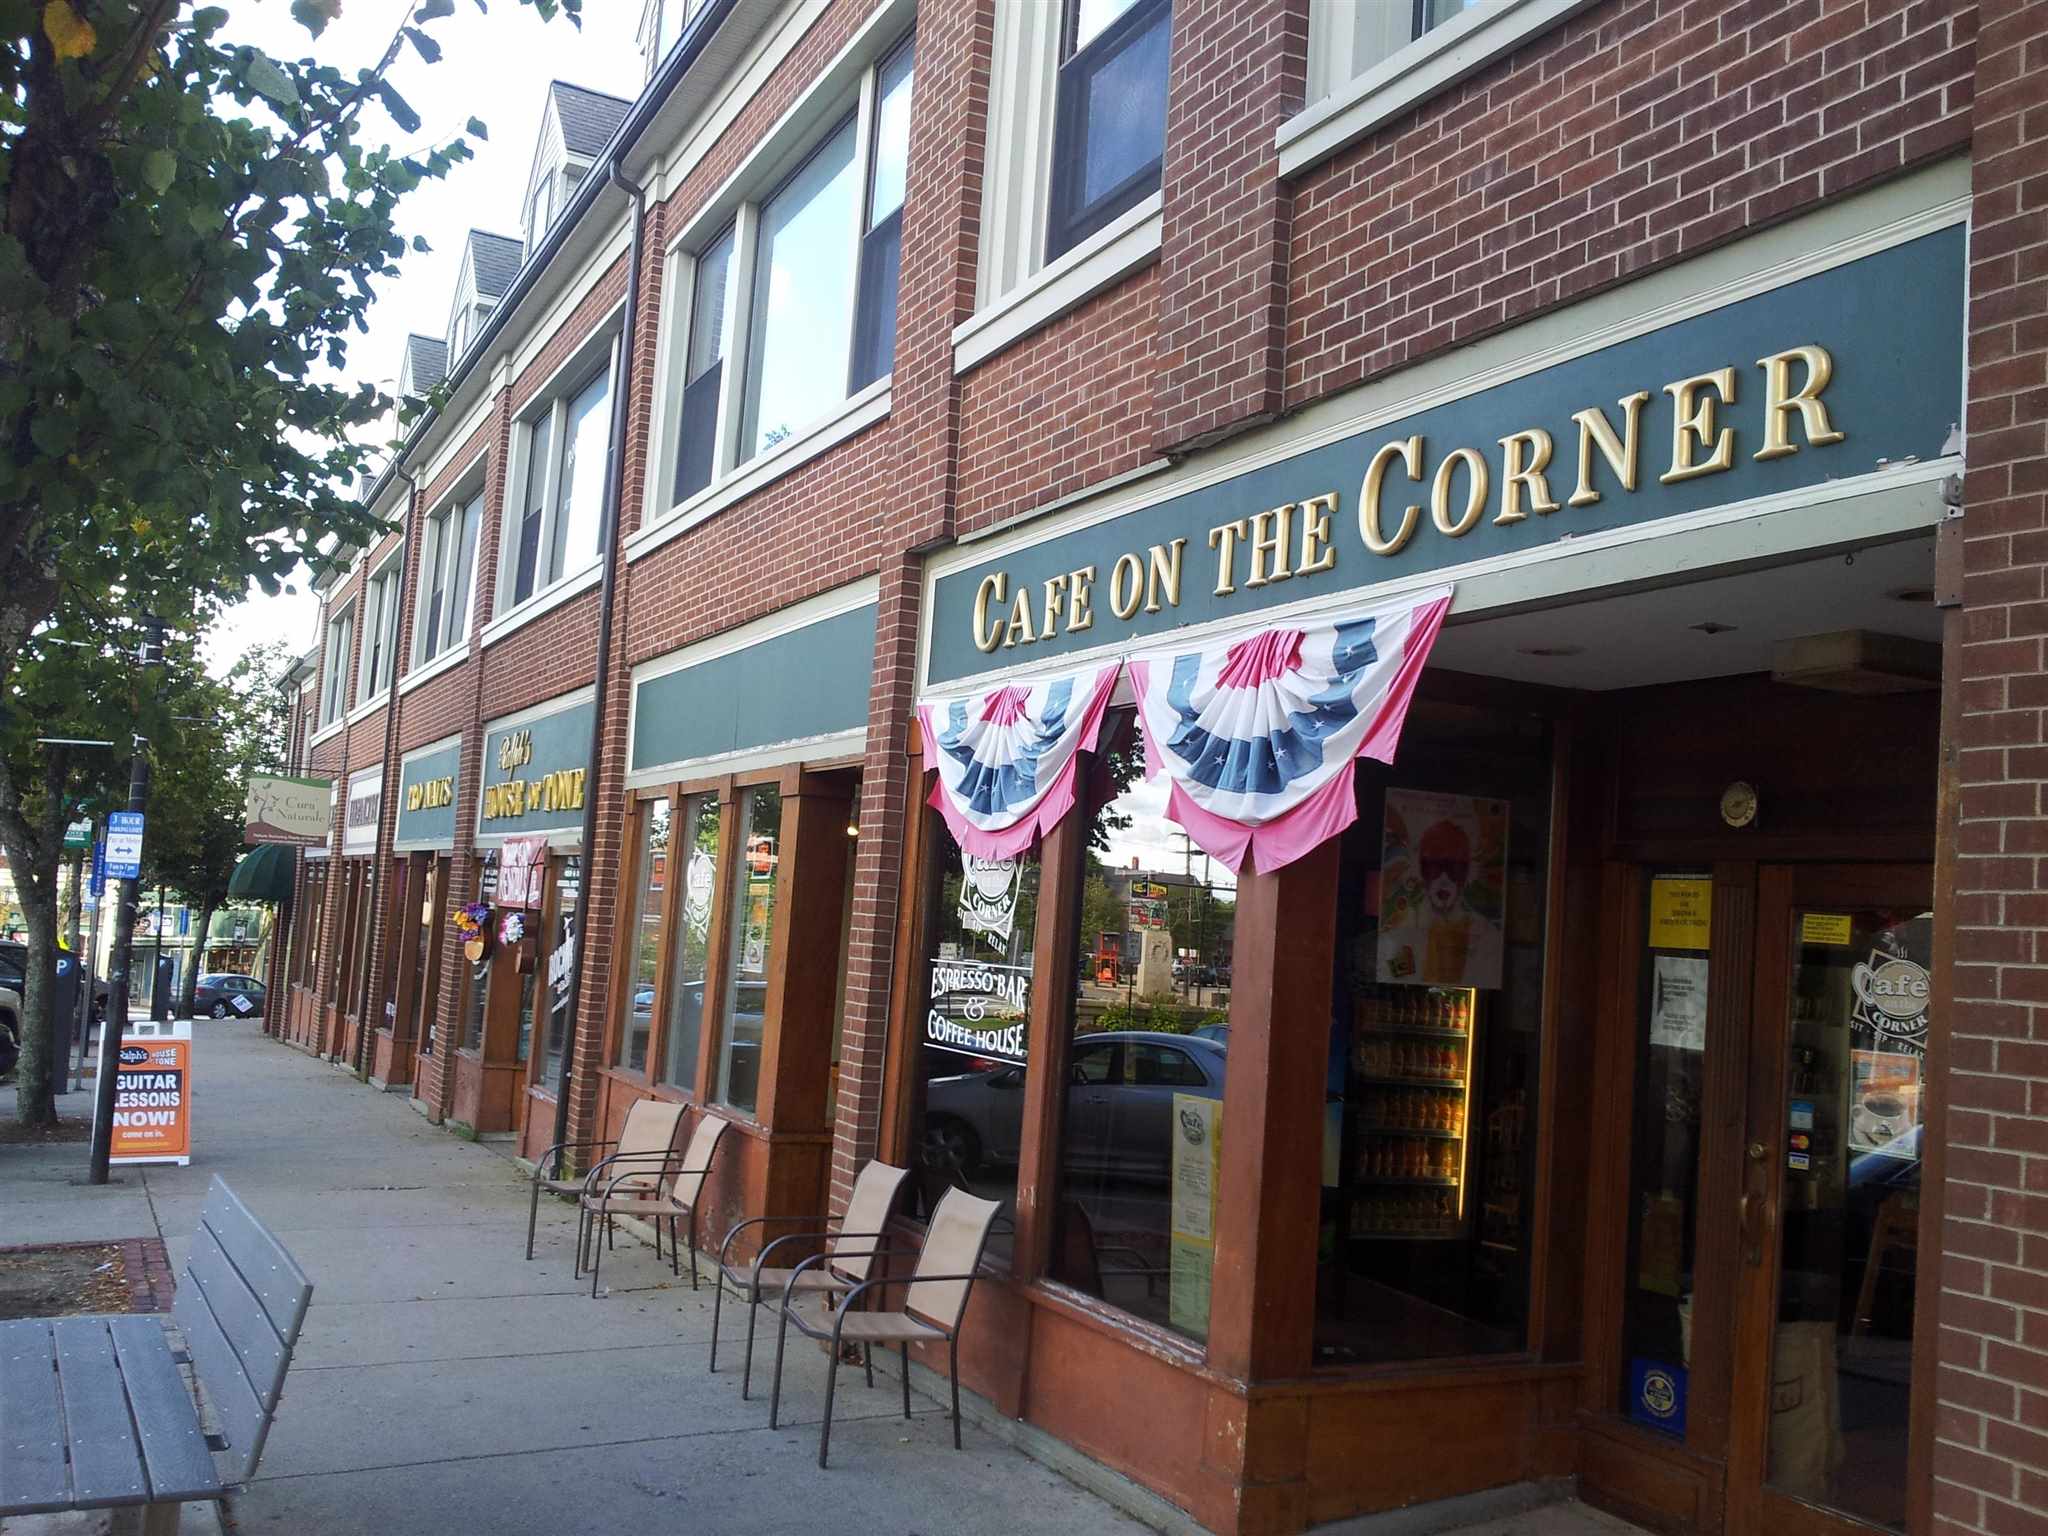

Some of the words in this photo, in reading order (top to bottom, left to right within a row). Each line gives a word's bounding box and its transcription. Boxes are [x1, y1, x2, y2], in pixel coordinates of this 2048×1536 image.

[973, 566, 1096, 654] CAFE
[1109, 537, 1188, 621] ON
[1208, 491, 1340, 597] THE
[1358, 344, 1846, 557] CORNER
[543, 768, 586, 812] TONE
[972, 891, 1012, 921] CORNER
[931, 966, 993, 999] ESPRESSO
[997, 975, 1025, 1014] BAR
[963, 996, 988, 1022] &
[1872, 1010, 1928, 1033] CORNER
[928, 1009, 972, 1046] COFFEE
[975, 1024, 1024, 1056] HOUSE
[116, 1074, 177, 1090] GUITAR
[113, 1110, 176, 1127] NOW!
